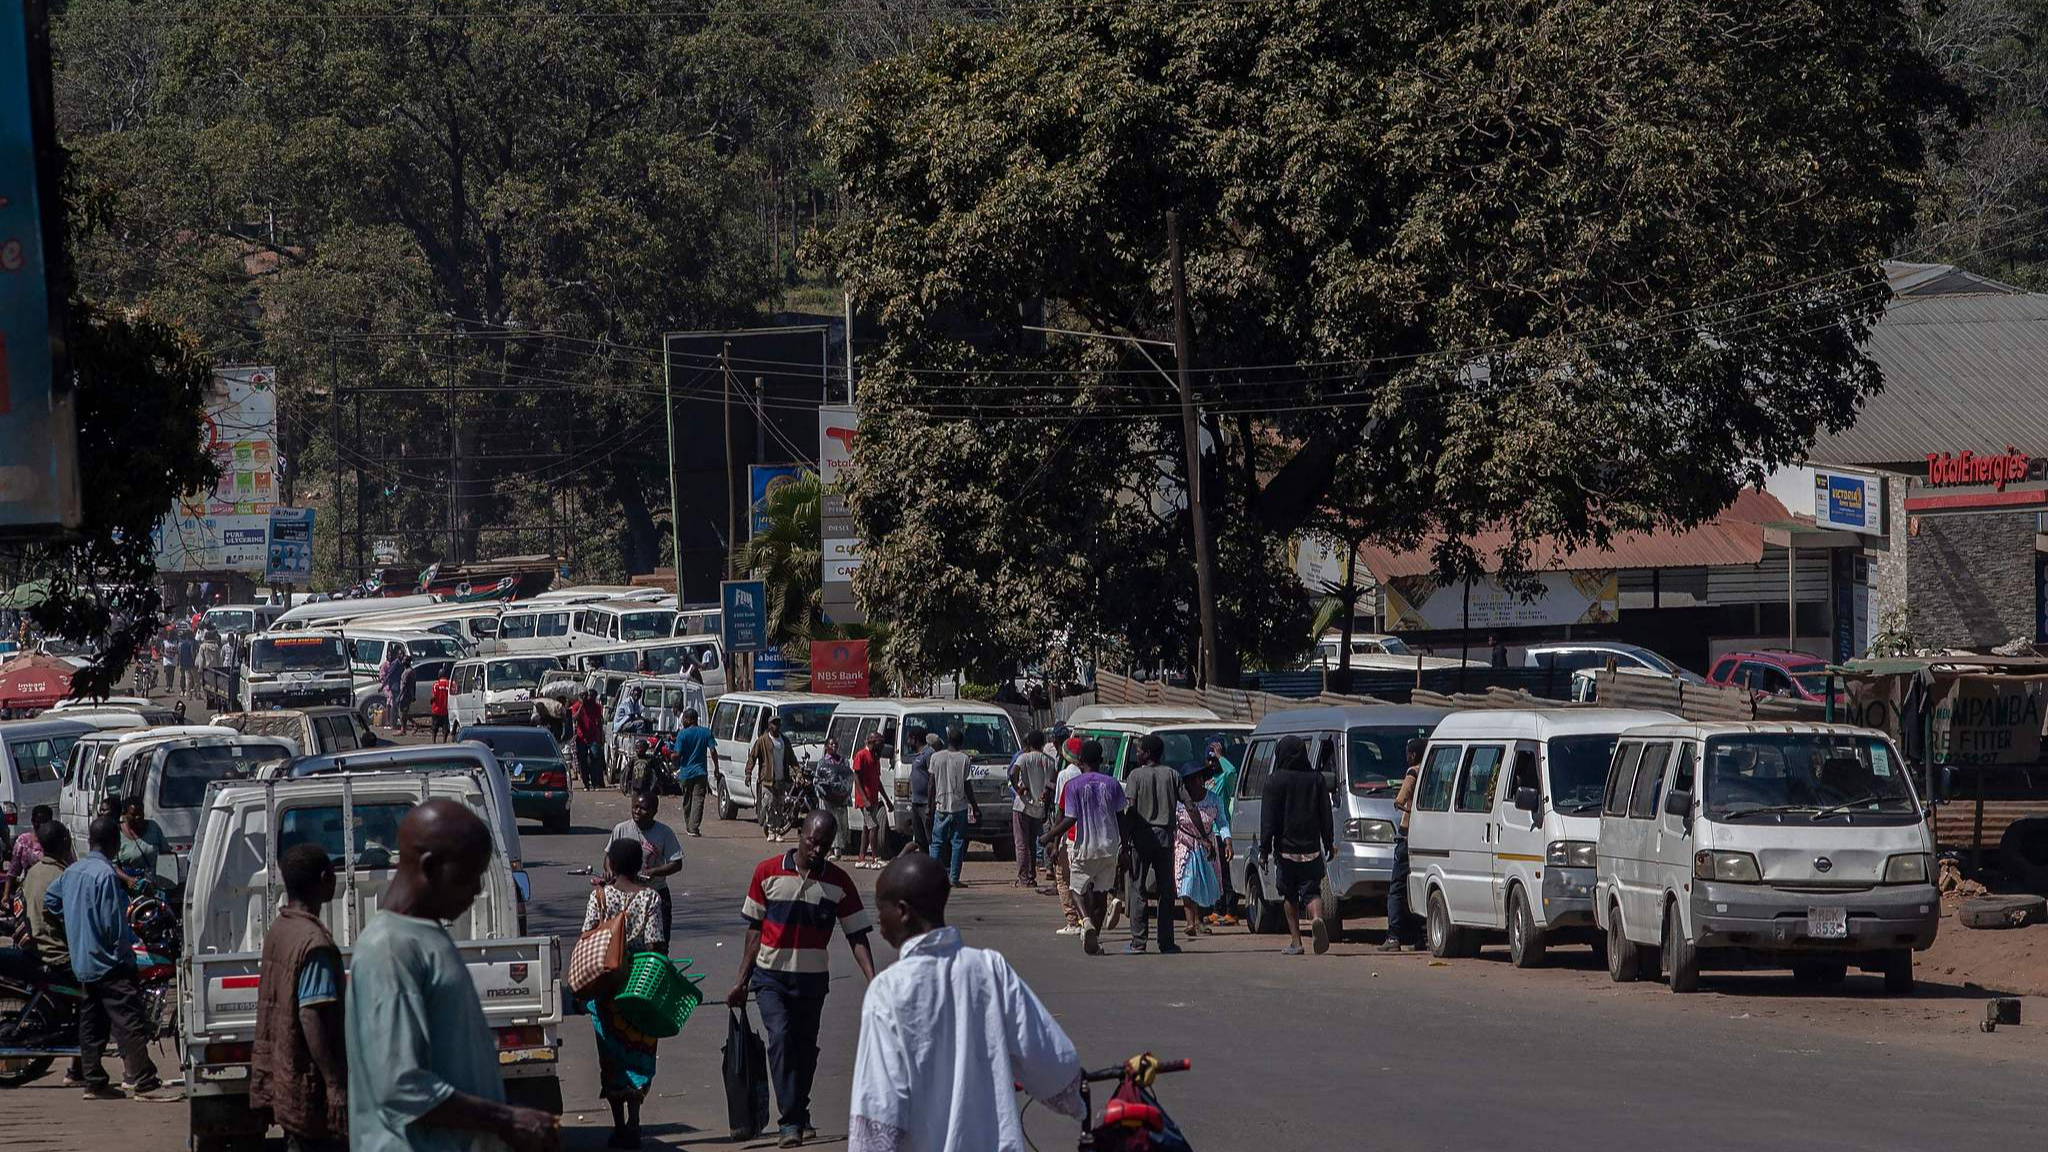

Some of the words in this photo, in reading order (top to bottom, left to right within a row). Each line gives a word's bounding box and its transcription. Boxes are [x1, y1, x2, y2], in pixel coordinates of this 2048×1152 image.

[1926, 444, 2028, 489] TotalEnergies
[225, 536, 265, 544] GLYCERINE
[817, 671, 837, 681] NBS
[839, 670, 864, 680] Bank
[1959, 730, 2012, 751] FITTER
[486, 987, 530, 998] mazda
